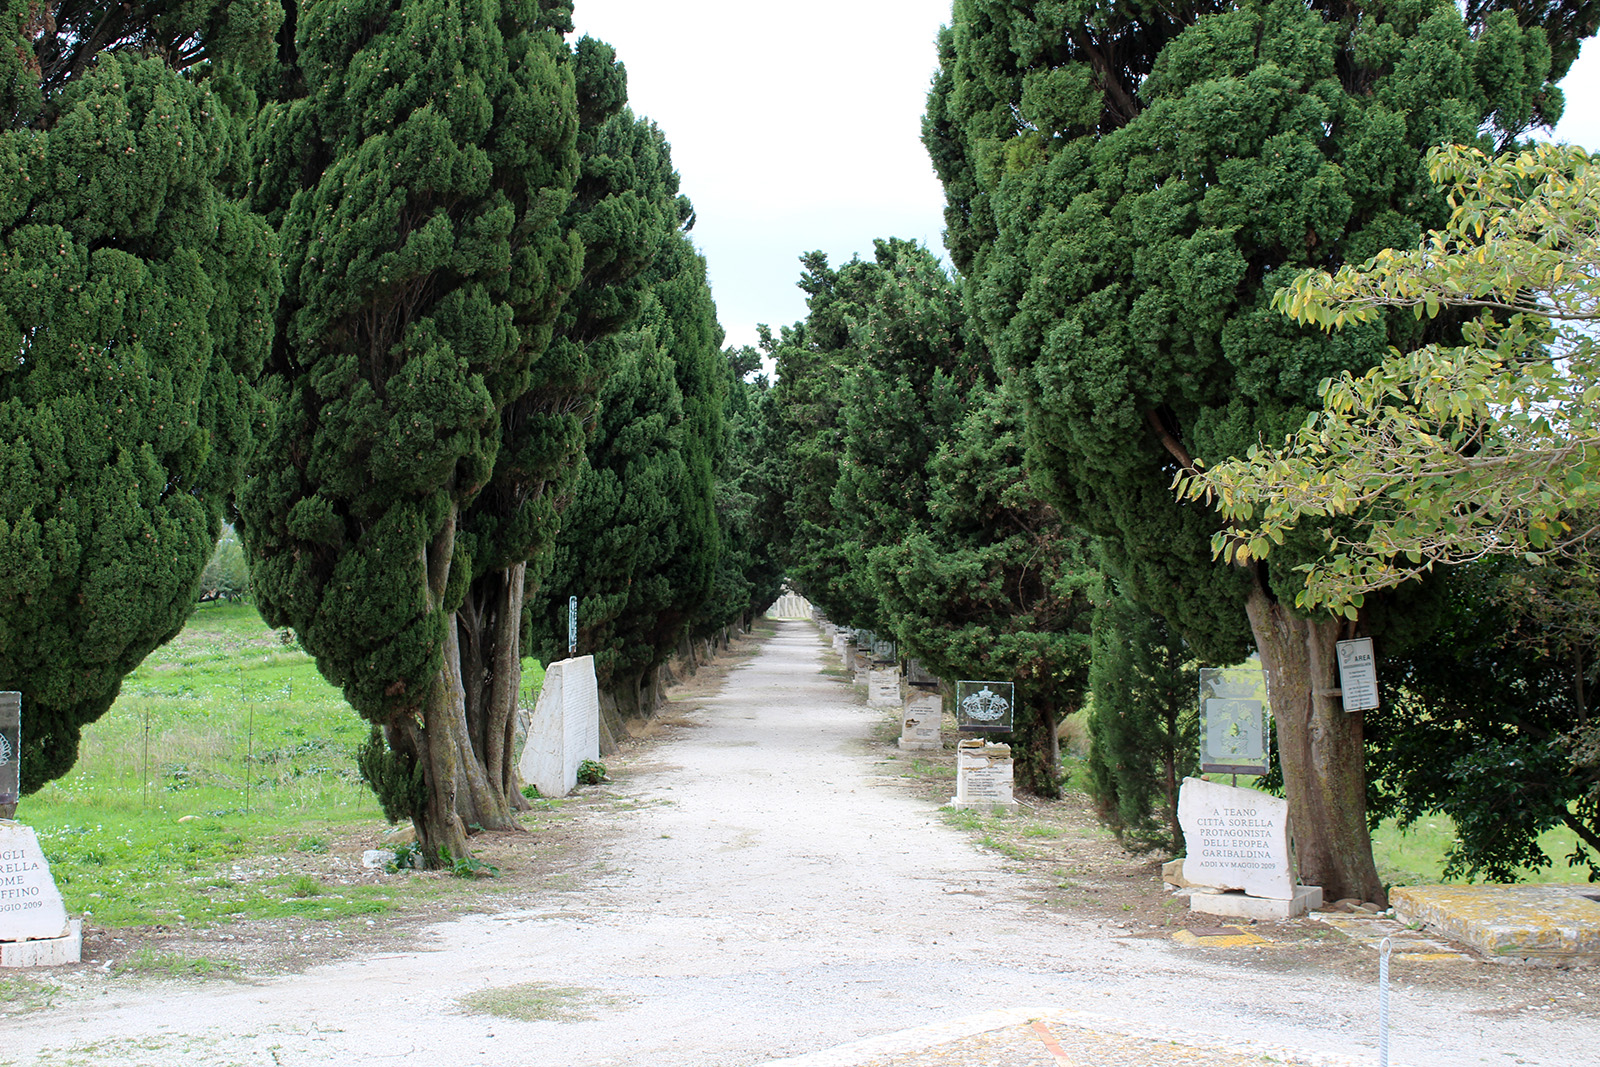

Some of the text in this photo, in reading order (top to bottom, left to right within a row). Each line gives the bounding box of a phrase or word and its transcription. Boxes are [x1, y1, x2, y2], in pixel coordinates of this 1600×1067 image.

[1224, 808, 1257, 817] TEANO
[1197, 817, 1274, 828] CITTÀ SORELLA
[1200, 828, 1272, 838] PROTAGONISTA
[0, 850, 25, 861] GLI
[1202, 849, 1271, 859] GARIBALDINA
[1260, 862, 1276, 870] 2009
[1, 886, 39, 899] FFINO
[23, 901, 42, 909] 2009
